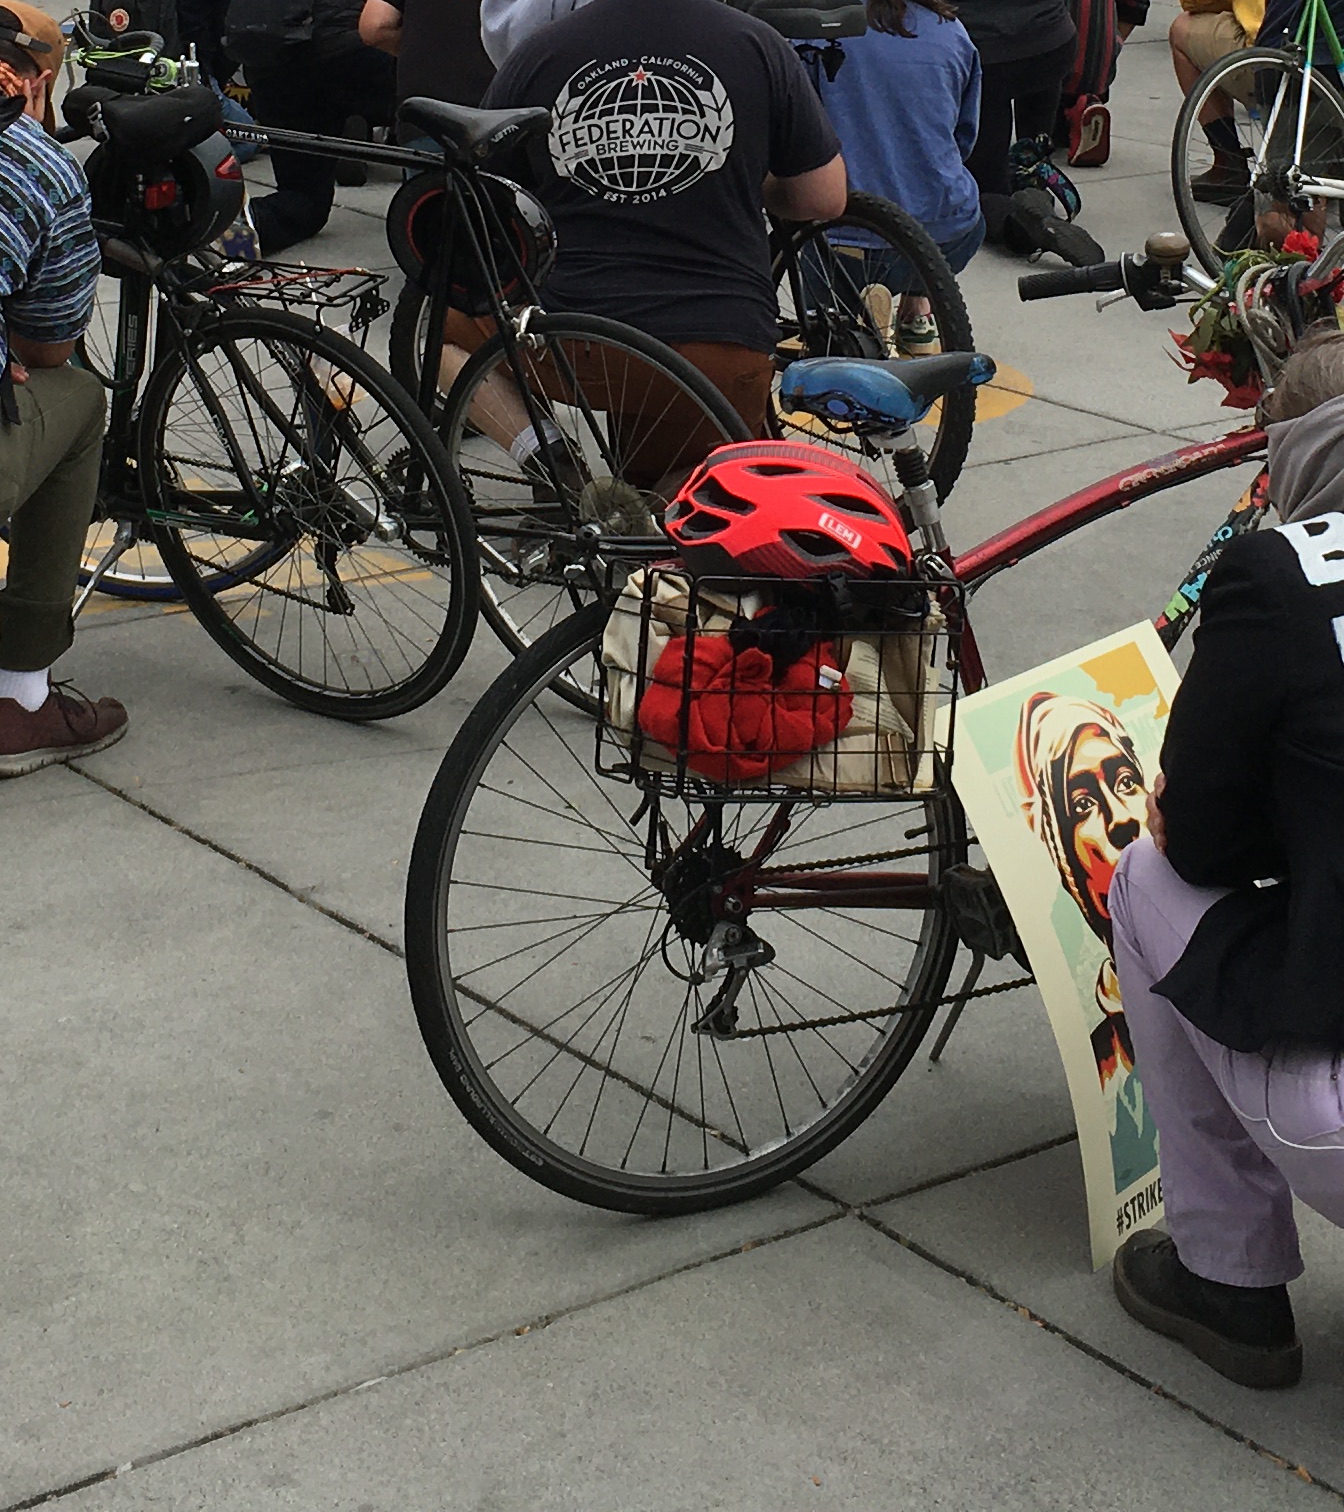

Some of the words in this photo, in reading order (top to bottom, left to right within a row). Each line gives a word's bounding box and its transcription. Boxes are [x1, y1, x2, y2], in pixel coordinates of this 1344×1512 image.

[577, 58, 629, 90] OAKLAND
[640, 56, 704, 85] CALIFORNIA
[558, 117, 721, 153] FEDERATION
[596, 139, 679, 156] BREWING
[603, 191, 627, 204] EST
[632, 190, 667, 204] 2014
[827, 517, 855, 542] LEM
